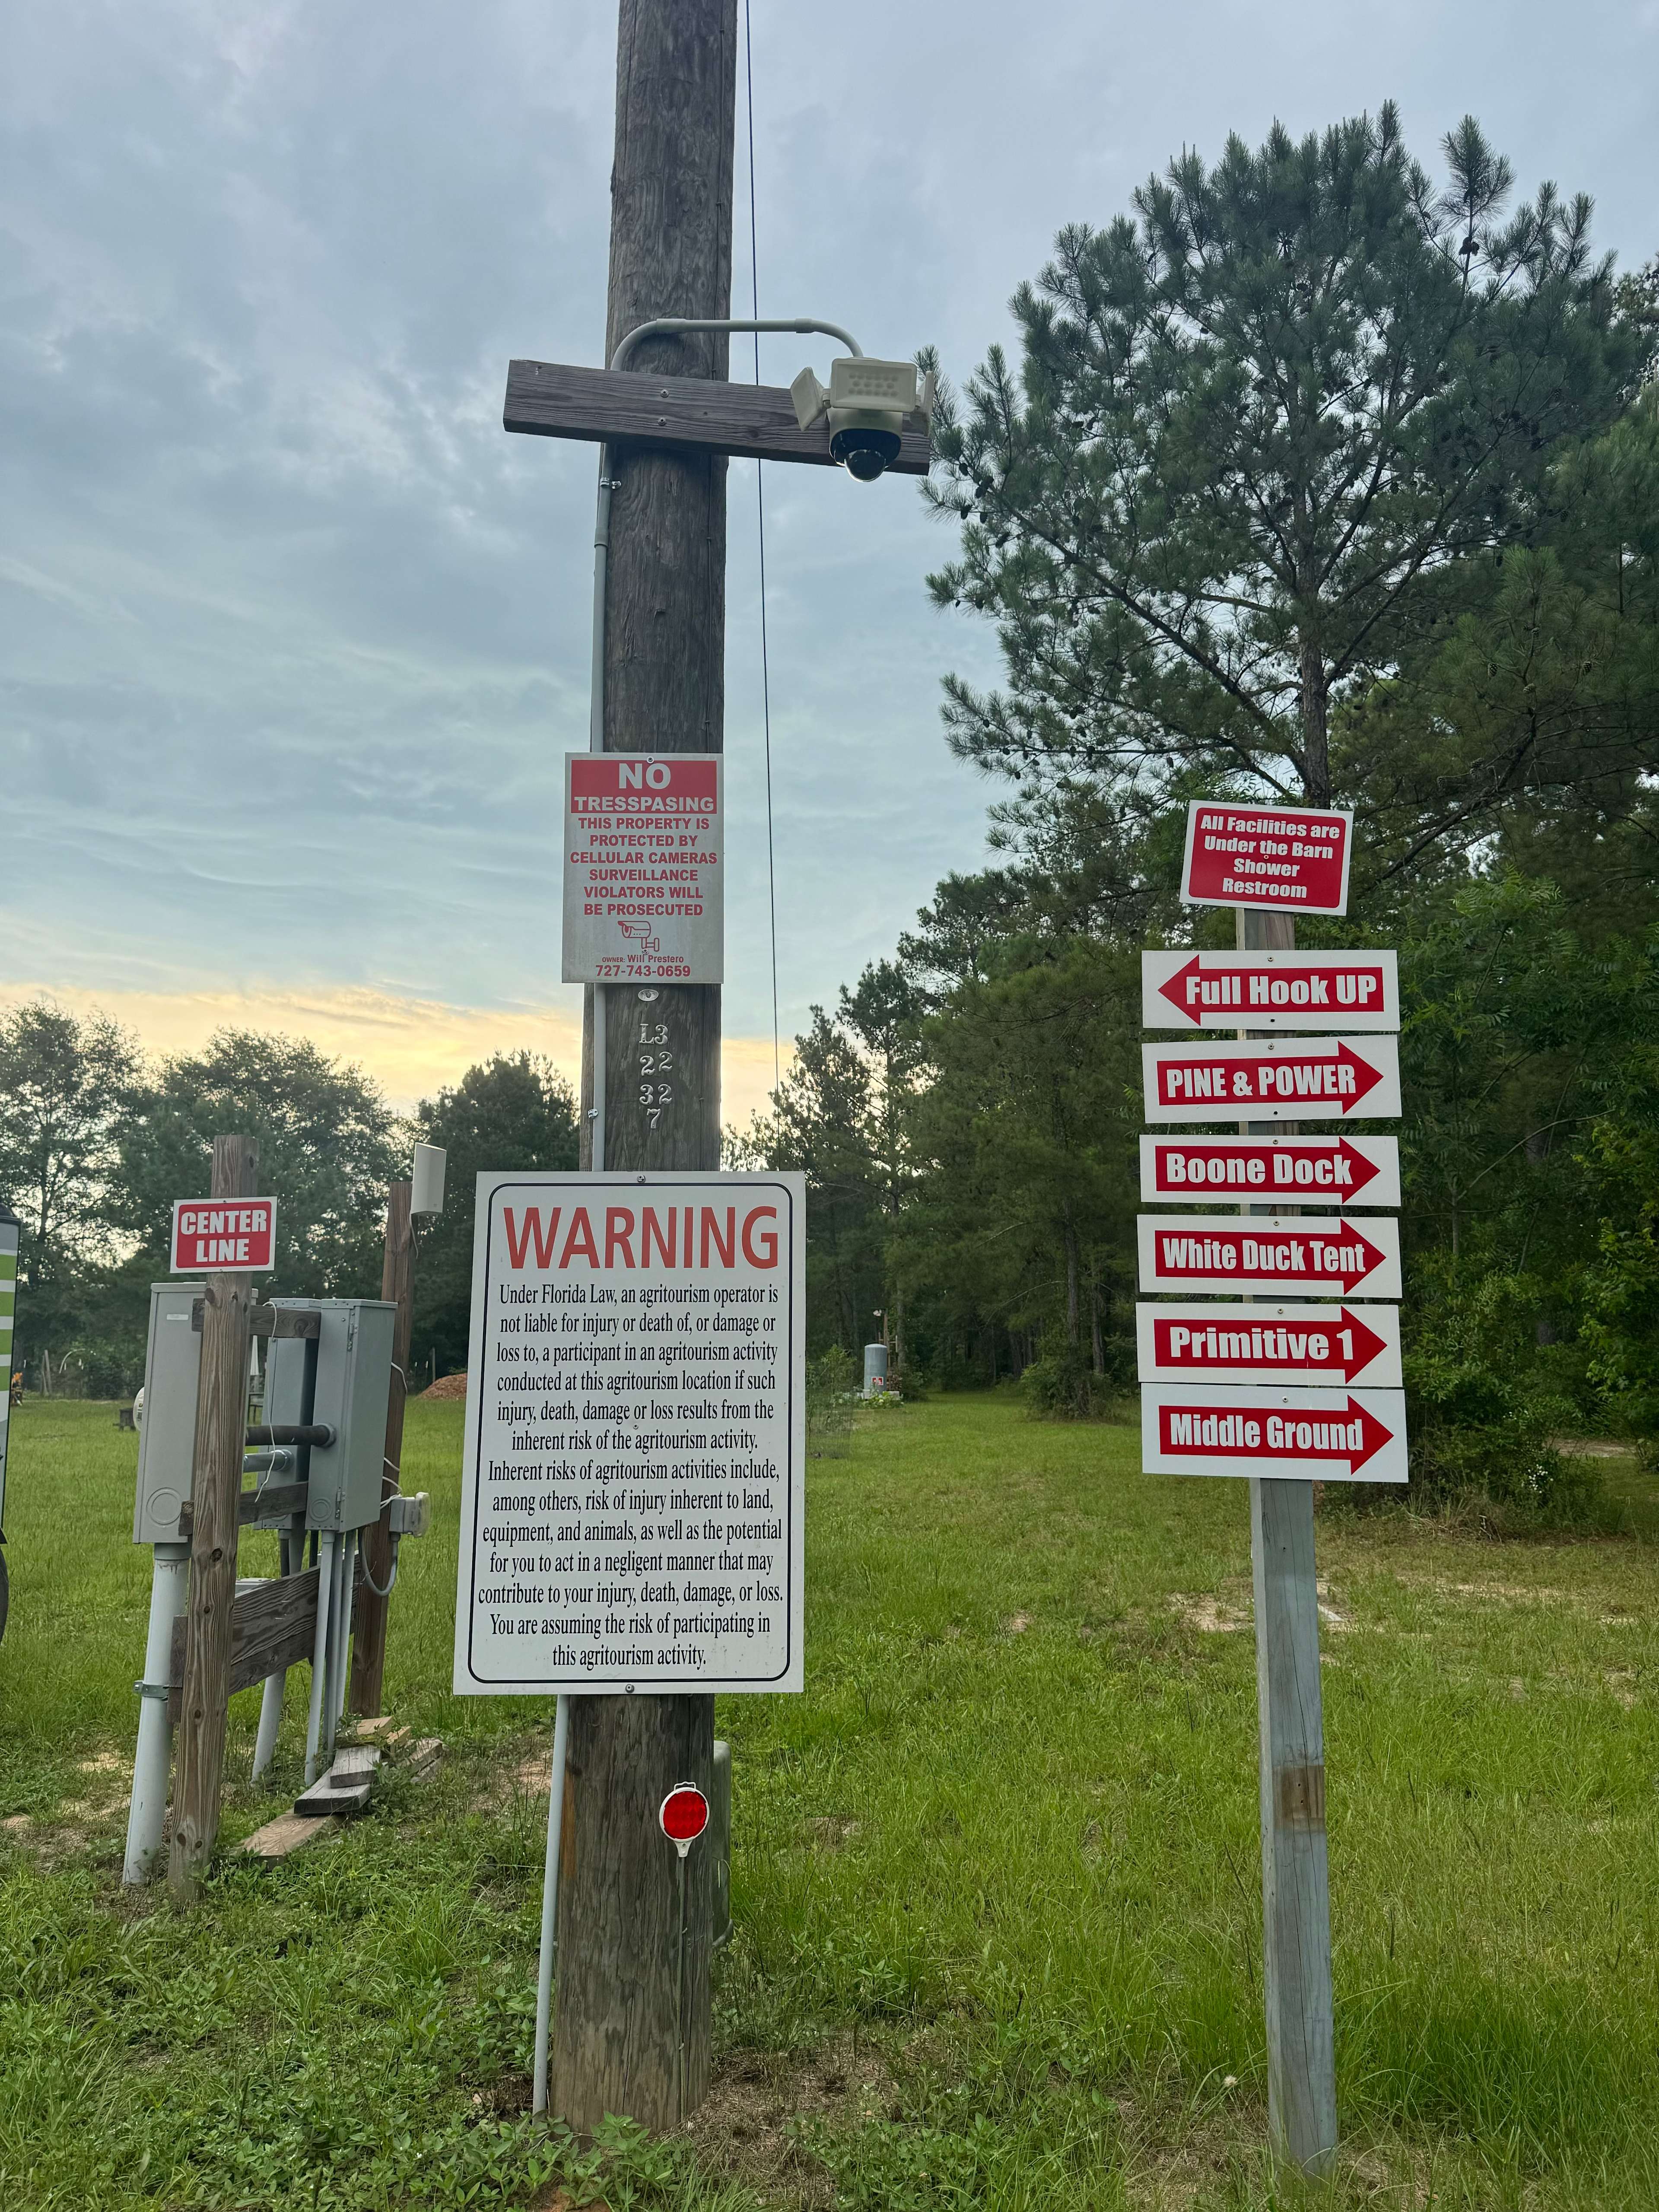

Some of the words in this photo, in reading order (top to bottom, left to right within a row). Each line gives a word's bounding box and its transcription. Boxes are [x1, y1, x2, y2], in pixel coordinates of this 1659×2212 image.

[619, 763, 671, 789] NO
[574, 797, 714, 812] TRESSPASING
[578, 817, 611, 829] THIS
[617, 817, 691, 830] PROPERTY
[696, 818, 709, 830] IS
[1201, 815, 1224, 830] All
[1227, 817, 1306, 836] Facilities
[1310, 824, 1340, 839] are
[590, 835, 674, 846] PROTECTED
[679, 835, 698, 846] BY
[1205, 836, 1256, 853] Under
[1260, 840, 1288, 856] the
[1292, 842, 1333, 859] Barn
[570, 852, 644, 864] CELLULAR
[649, 852, 717, 864] CAMERAS
[1233, 858, 1300, 877] Shower
[589, 869, 698, 881] SURVEILLANCE
[584, 886, 664, 899] VIOLATORS
[669, 887, 703, 899] WILL
[1222, 878, 1307, 898] Restroom
[584, 903, 602, 915] BE
[607, 904, 703, 916] PROSECUTED
[595, 965, 691, 977] 727-743-0659
[627, 954, 645, 963] Will
[1186, 976, 1241, 1004] Full
[1249, 975, 1329, 1004] Hook
[1336, 975, 1376, 1004] UP
[639, 1023, 668, 1045] L3
[639, 1051, 673, 1076] 22
[1166, 1068, 1227, 1098] PINE
[1233, 1071, 1253, 1096] &
[1258, 1065, 1356, 1096] POWER
[639, 1084, 672, 1105] 32
[647, 1108, 661, 1129] 7
[1166, 1153, 1265, 1184] Boone
[1273, 1154, 1353, 1184] Dock
[181, 1210, 267, 1235] CENTER
[503, 1205, 778, 1269] WARNING
[196, 1239, 249, 1262] LINE
[1163, 1238, 1236, 1270] White
[1243, 1239, 1306, 1271] Duck
[1309, 1241, 1366, 1273] Tent
[500, 1284, 538, 1304] Under
[541, 1284, 586, 1303] Florida
[590, 1284, 617, 1307] Law,
[621, 1289, 636, 1303] an
[639, 1283, 710, 1308] agritourism
[714, 1285, 765, 1308] operator
[769, 1283, 778, 1303] is
[500, 1315, 521, 1332] not
[524, 1313, 557, 1332] liable
[561, 1313, 579, 1332] for
[582, 1313, 619, 1337] injury
[623, 1318, 636, 1332] or
[639, 1312, 673, 1332] death
[677, 1312, 692, 1335] of,
[696, 1317, 709, 1332] or
[713, 1312, 759, 1337] damage
[763, 1317, 776, 1332] or
[496, 1342, 519, 1362] loss
[523, 1344, 539, 1365] to,
[543, 1347, 550, 1361] a
[553, 1341, 621, 1367] participant
[624, 1341, 636, 1360] in
[640, 1347, 655, 1361] an
[658, 1341, 730, 1366] agritourism
[733, 1341, 778, 1366] activity
[1170, 1327, 1329, 1360] Primitive
[1336, 1329, 1354, 1360] 1
[497, 1370, 561, 1391] conducted
[565, 1373, 577, 1391] at
[581, 1370, 603, 1390] this
[607, 1370, 678, 1395] agritourism
[682, 1370, 731, 1390] location
[735, 1370, 745, 1389] if
[747, 1370, 775, 1389] such
[497, 1401, 536, 1426] injury,
[540, 1400, 578, 1424] death,
[582, 1400, 630, 1425] damage
[634, 1405, 647, 1420] or
[650, 1399, 673, 1419] loss
[677, 1399, 718, 1419] results
[721, 1399, 750, 1419] from
[754, 1399, 774, 1419] the
[512, 1430, 565, 1450] inherent
[568, 1430, 592, 1450] risk
[596, 1429, 610, 1449] of
[612, 1429, 632, 1449] the
[635, 1429, 707, 1455] agritourism
[711, 1428, 757, 1454] activity.
[1170, 1414, 1261, 1448] Middle
[1267, 1416, 1363, 1451] Ground
[488, 1460, 543, 1481] Inherent
[546, 1459, 575, 1480] risks
[579, 1459, 594, 1480] of
[595, 1459, 667, 1485] agritourism
[671, 1459, 726, 1479] activities
[730, 1458, 779, 1483] include,
[493, 1496, 536, 1516] among
[539, 1490, 581, 1514] others,
[585, 1489, 609, 1510] risk
[613, 1489, 627, 1510] of
[629, 1489, 667, 1515] injury
[670, 1489, 723, 1510] inherent
[727, 1491, 739, 1509] to
[743, 1488, 773, 1513] land,
[483, 1521, 553, 1548] equipment,
[557, 1520, 581, 1541] and
[585, 1519, 636, 1545] animals,
[641, 1526, 653, 1540] as
[657, 1519, 682, 1540] well
[686, 1525, 699, 1540] as
[703, 1519, 723, 1540] the
[726, 1519, 782, 1545] potential
[489, 1551, 509, 1573] for
[511, 1557, 535, 1578] you
[539, 1554, 551, 1572] to
[555, 1553, 574, 1572] act
[577, 1551, 590, 1571] in
[594, 1557, 601, 1572] a
[604, 1550, 663, 1577] negligent
[667, 1556, 715, 1571] manner
[718, 1549, 744, 1570] that
[747, 1555, 773, 1576] may
[478, 1582, 544, 1604] contribute
[548, 1584, 560, 1603] to
[563, 1588, 594, 1609] your
[597, 1581, 636, 1608] injury,
[641, 1581, 679, 1606] death,
[683, 1581, 735, 1607] damage,
[739, 1586, 753, 1601] or
[756, 1580, 783, 1601] loss.
[490, 1614, 514, 1635] You
[518, 1619, 538, 1635] are
[541, 1613, 601, 1640] assuming
[605, 1612, 625, 1634] the
[629, 1612, 653, 1634] risk
[657, 1612, 671, 1634] of
[673, 1611, 754, 1639] participating
[758, 1611, 770, 1632] in
[553, 1644, 576, 1665] this
[580, 1644, 654, 1671] agritourism
[658, 1643, 706, 1670] activity.
